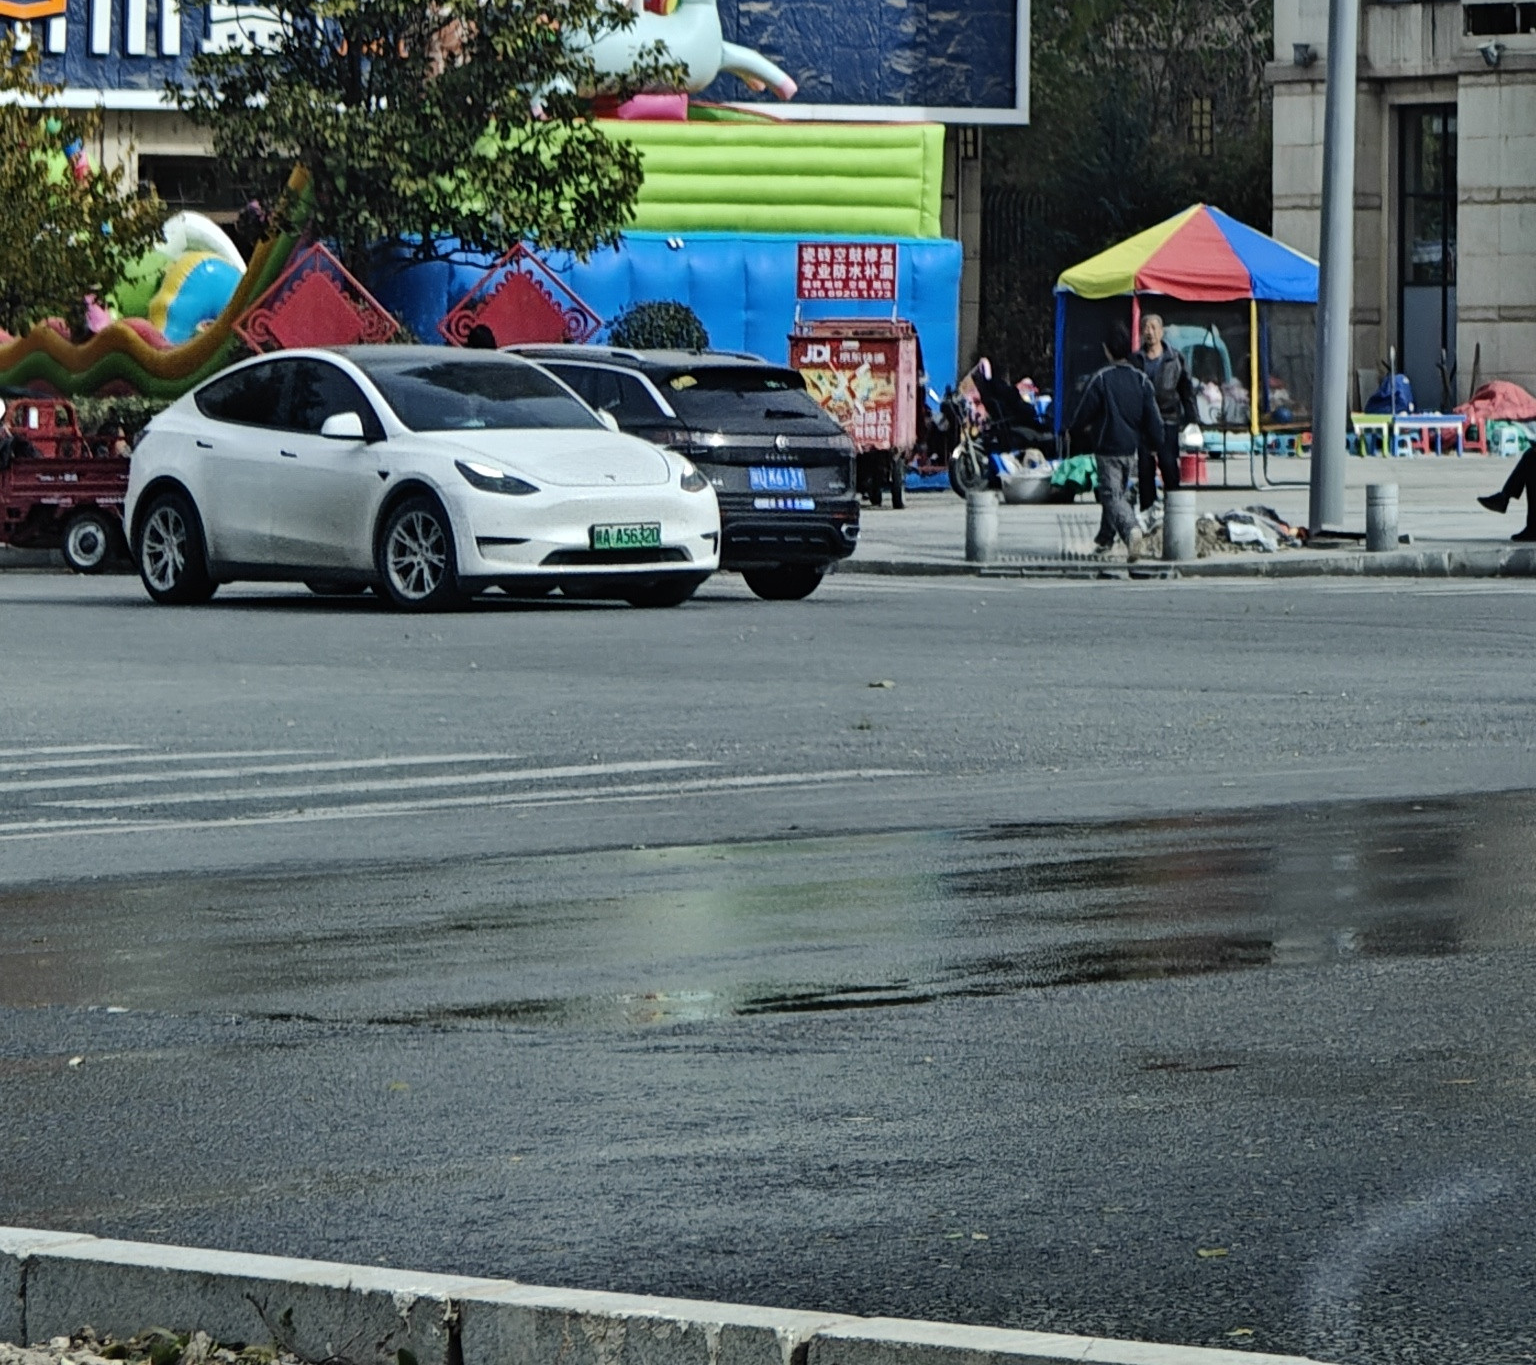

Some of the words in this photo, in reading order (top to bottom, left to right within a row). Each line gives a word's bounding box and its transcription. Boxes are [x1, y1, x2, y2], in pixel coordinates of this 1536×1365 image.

[801, 246, 894, 264] 瓷砖空鼓修复
[801, 262, 894, 280] 专业防水补漏
